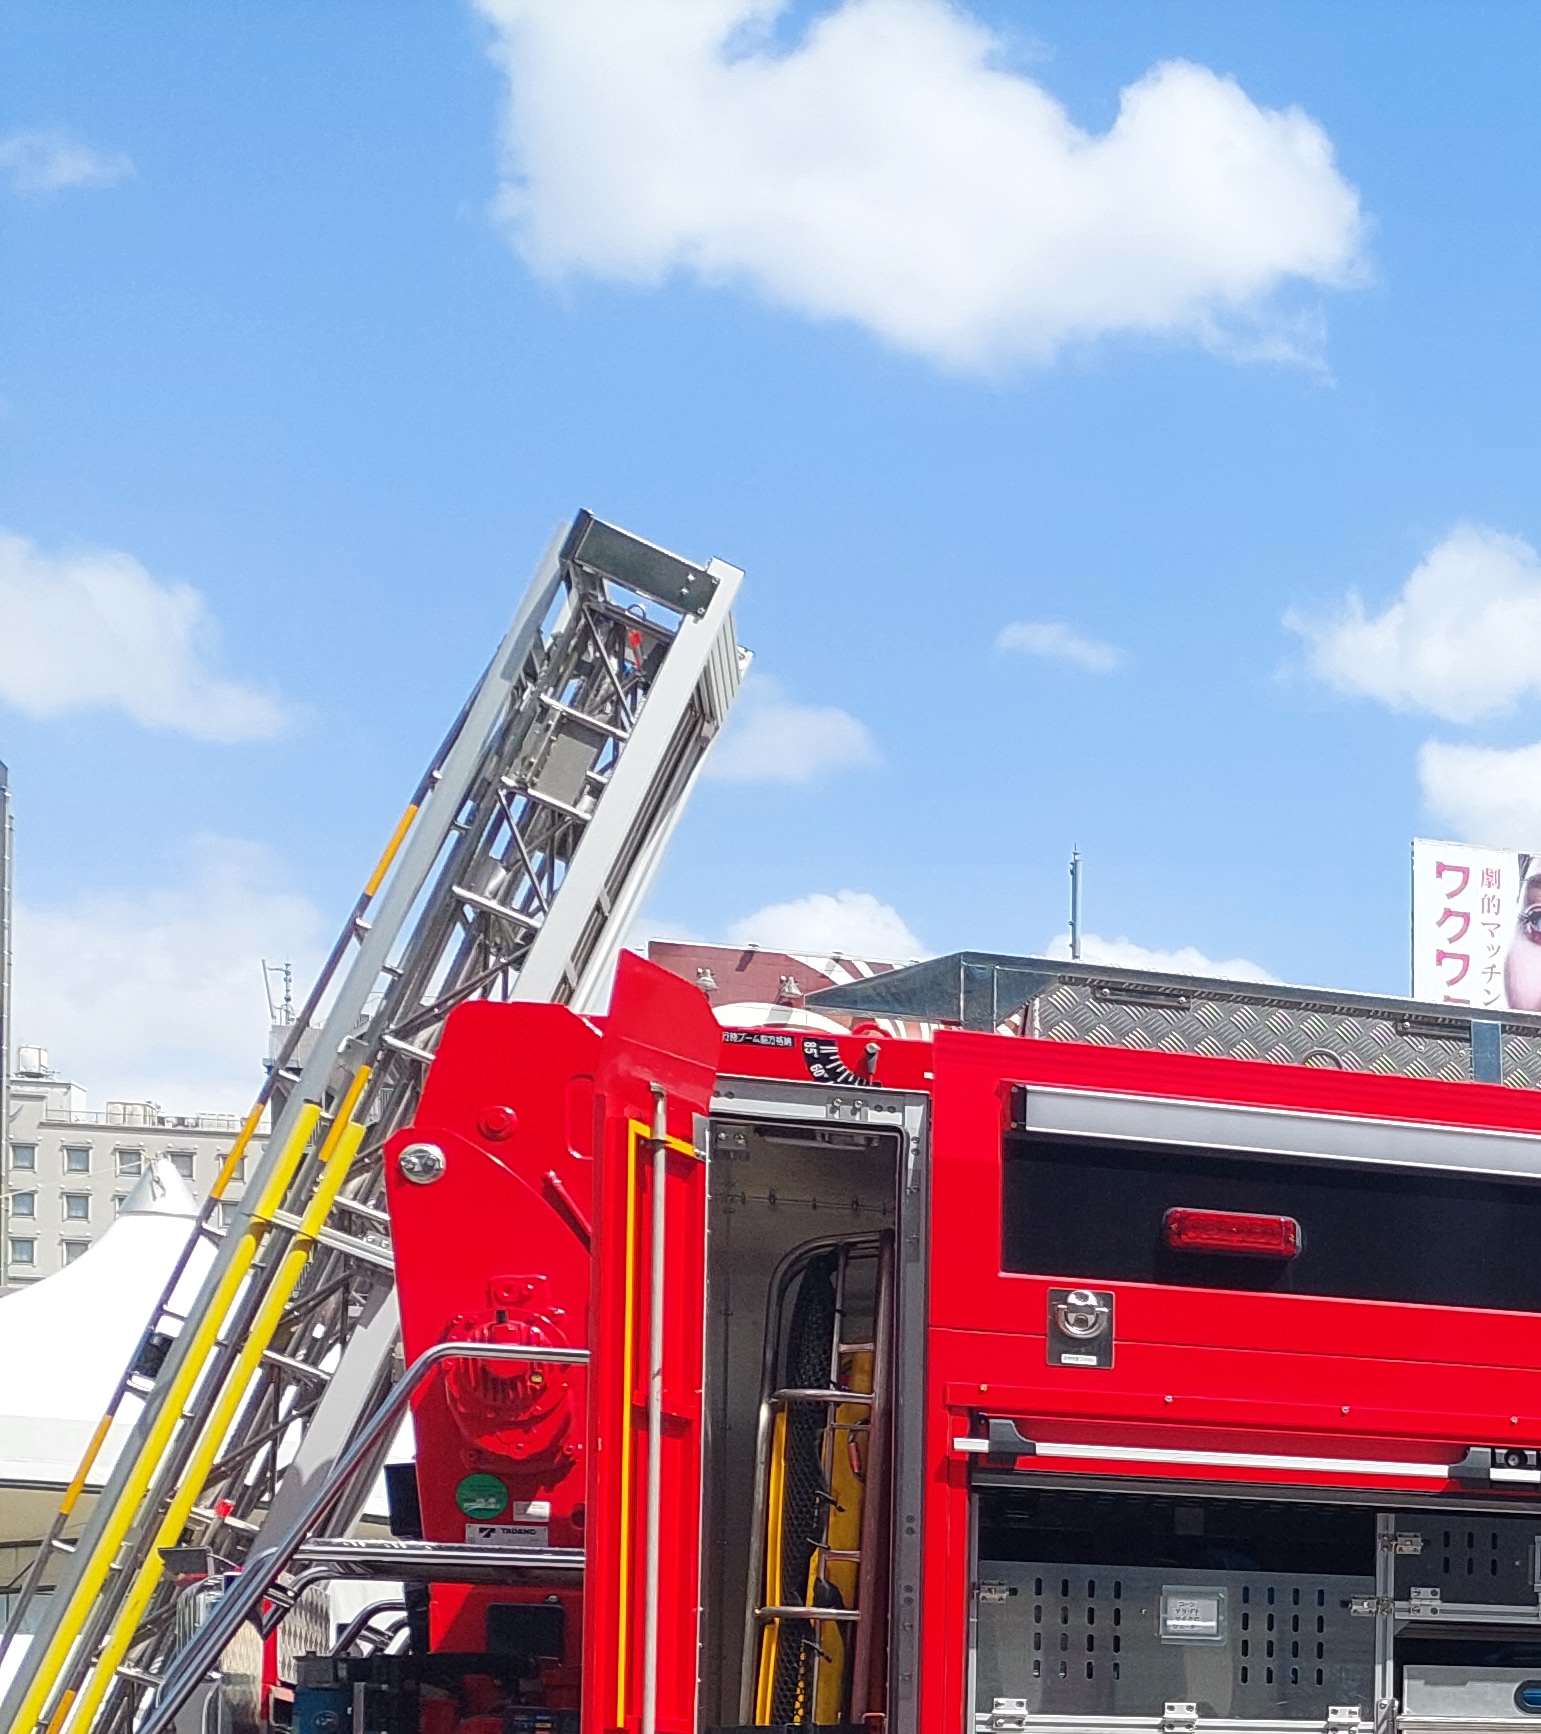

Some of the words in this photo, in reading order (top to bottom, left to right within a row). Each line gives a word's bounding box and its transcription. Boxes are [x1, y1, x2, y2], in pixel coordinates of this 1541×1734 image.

[1436, 861, 1471, 1006] ワクワ
[1481, 868, 1501, 1007] 劇的マッチン
